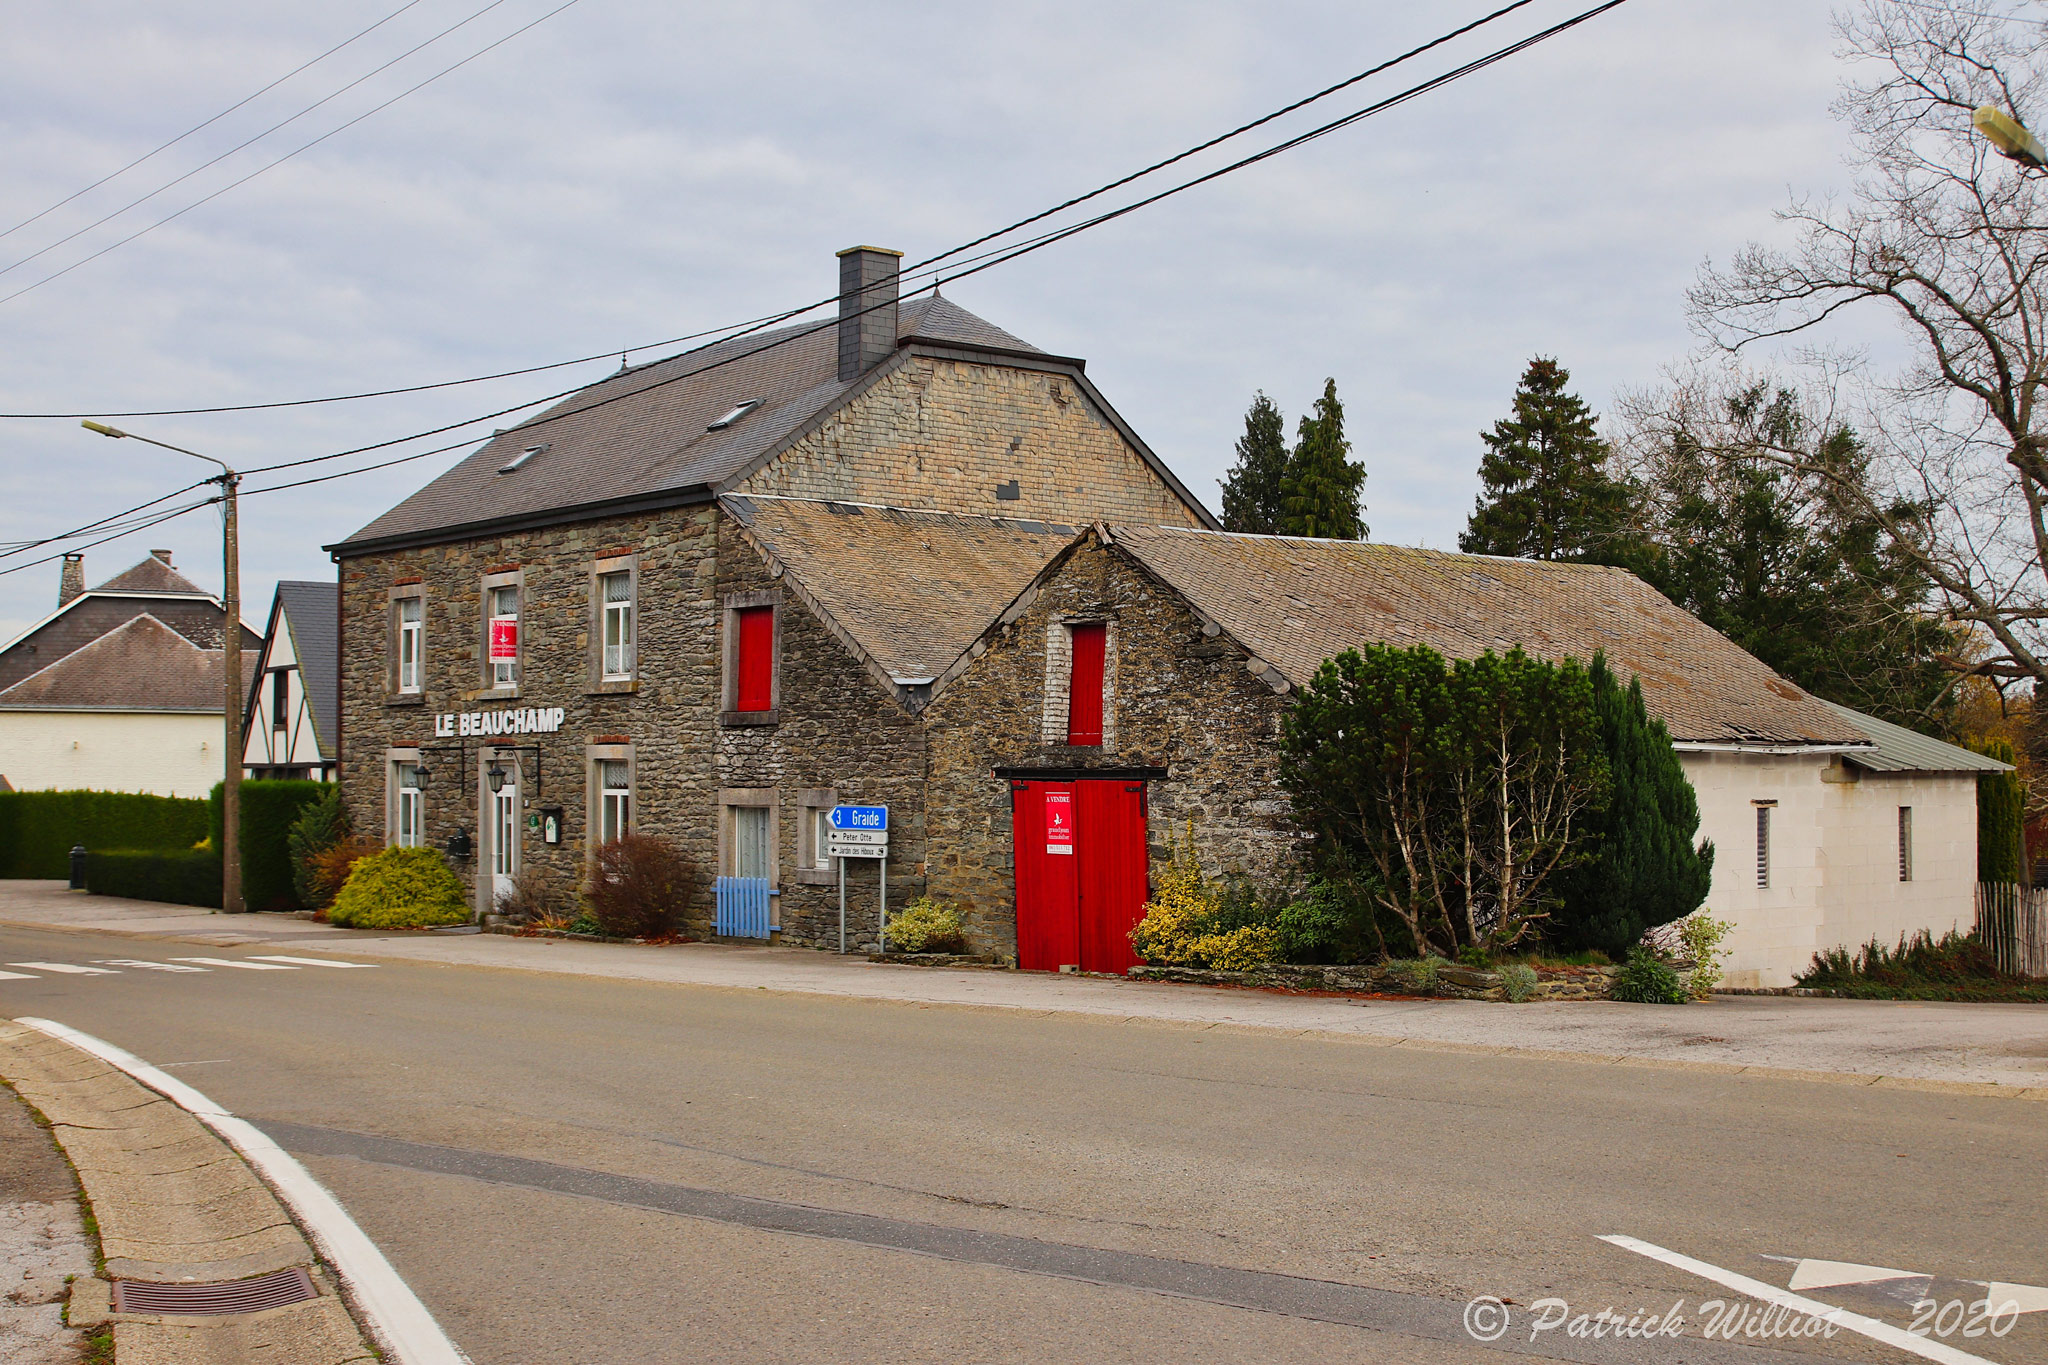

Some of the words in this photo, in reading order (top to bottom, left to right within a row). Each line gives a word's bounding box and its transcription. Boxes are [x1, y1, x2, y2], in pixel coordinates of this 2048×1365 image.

[435, 714, 454, 737] LE
[460, 707, 564, 736] BEAUCHAMP
[836, 810, 841, 825] 3
[852, 810, 879, 826] Graide
[843, 833, 857, 841] Peter
[860, 834, 872, 842] Otte
[839, 846, 851, 855] Jardin
[861, 847, 874, 855] Hiboux
